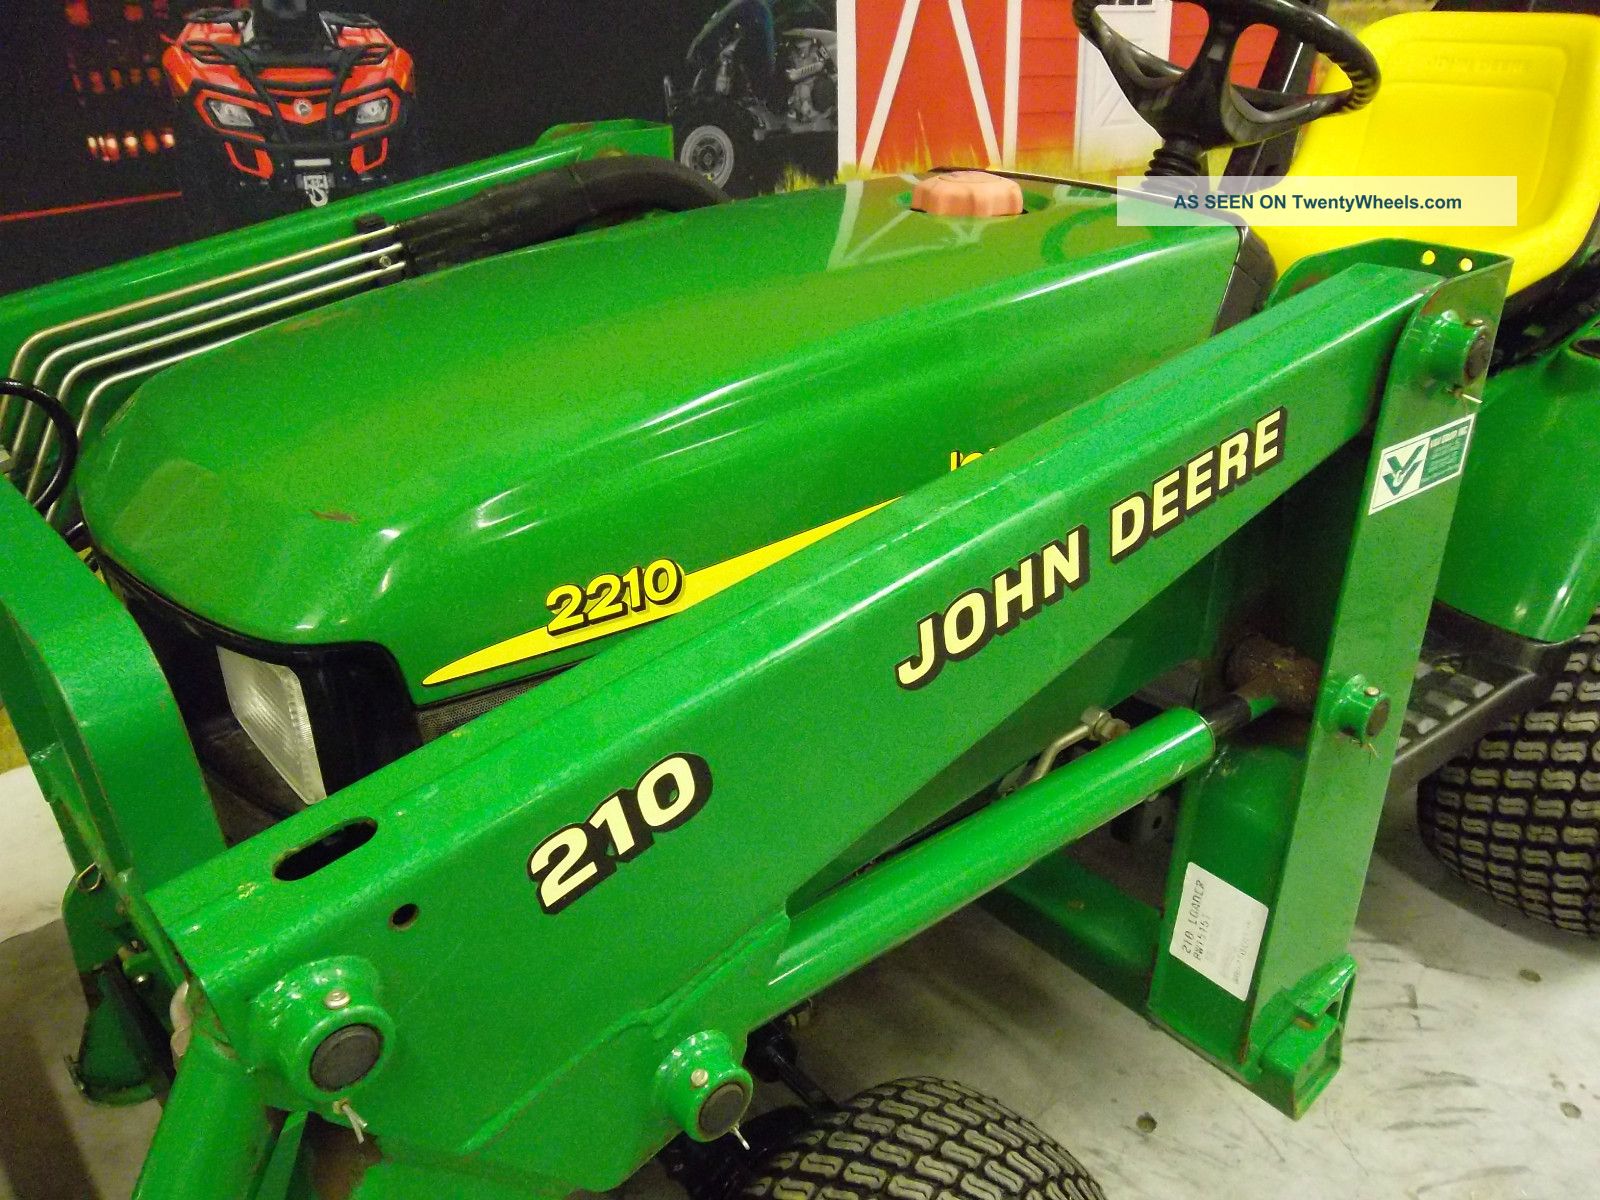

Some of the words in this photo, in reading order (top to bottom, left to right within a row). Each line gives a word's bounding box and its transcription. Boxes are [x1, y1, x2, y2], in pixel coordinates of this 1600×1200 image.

[546, 557, 687, 637] 2210
[894, 524, 1090, 690] JOHN
[1110, 405, 1287, 564] DEERE
[526, 752, 714, 915] 210
